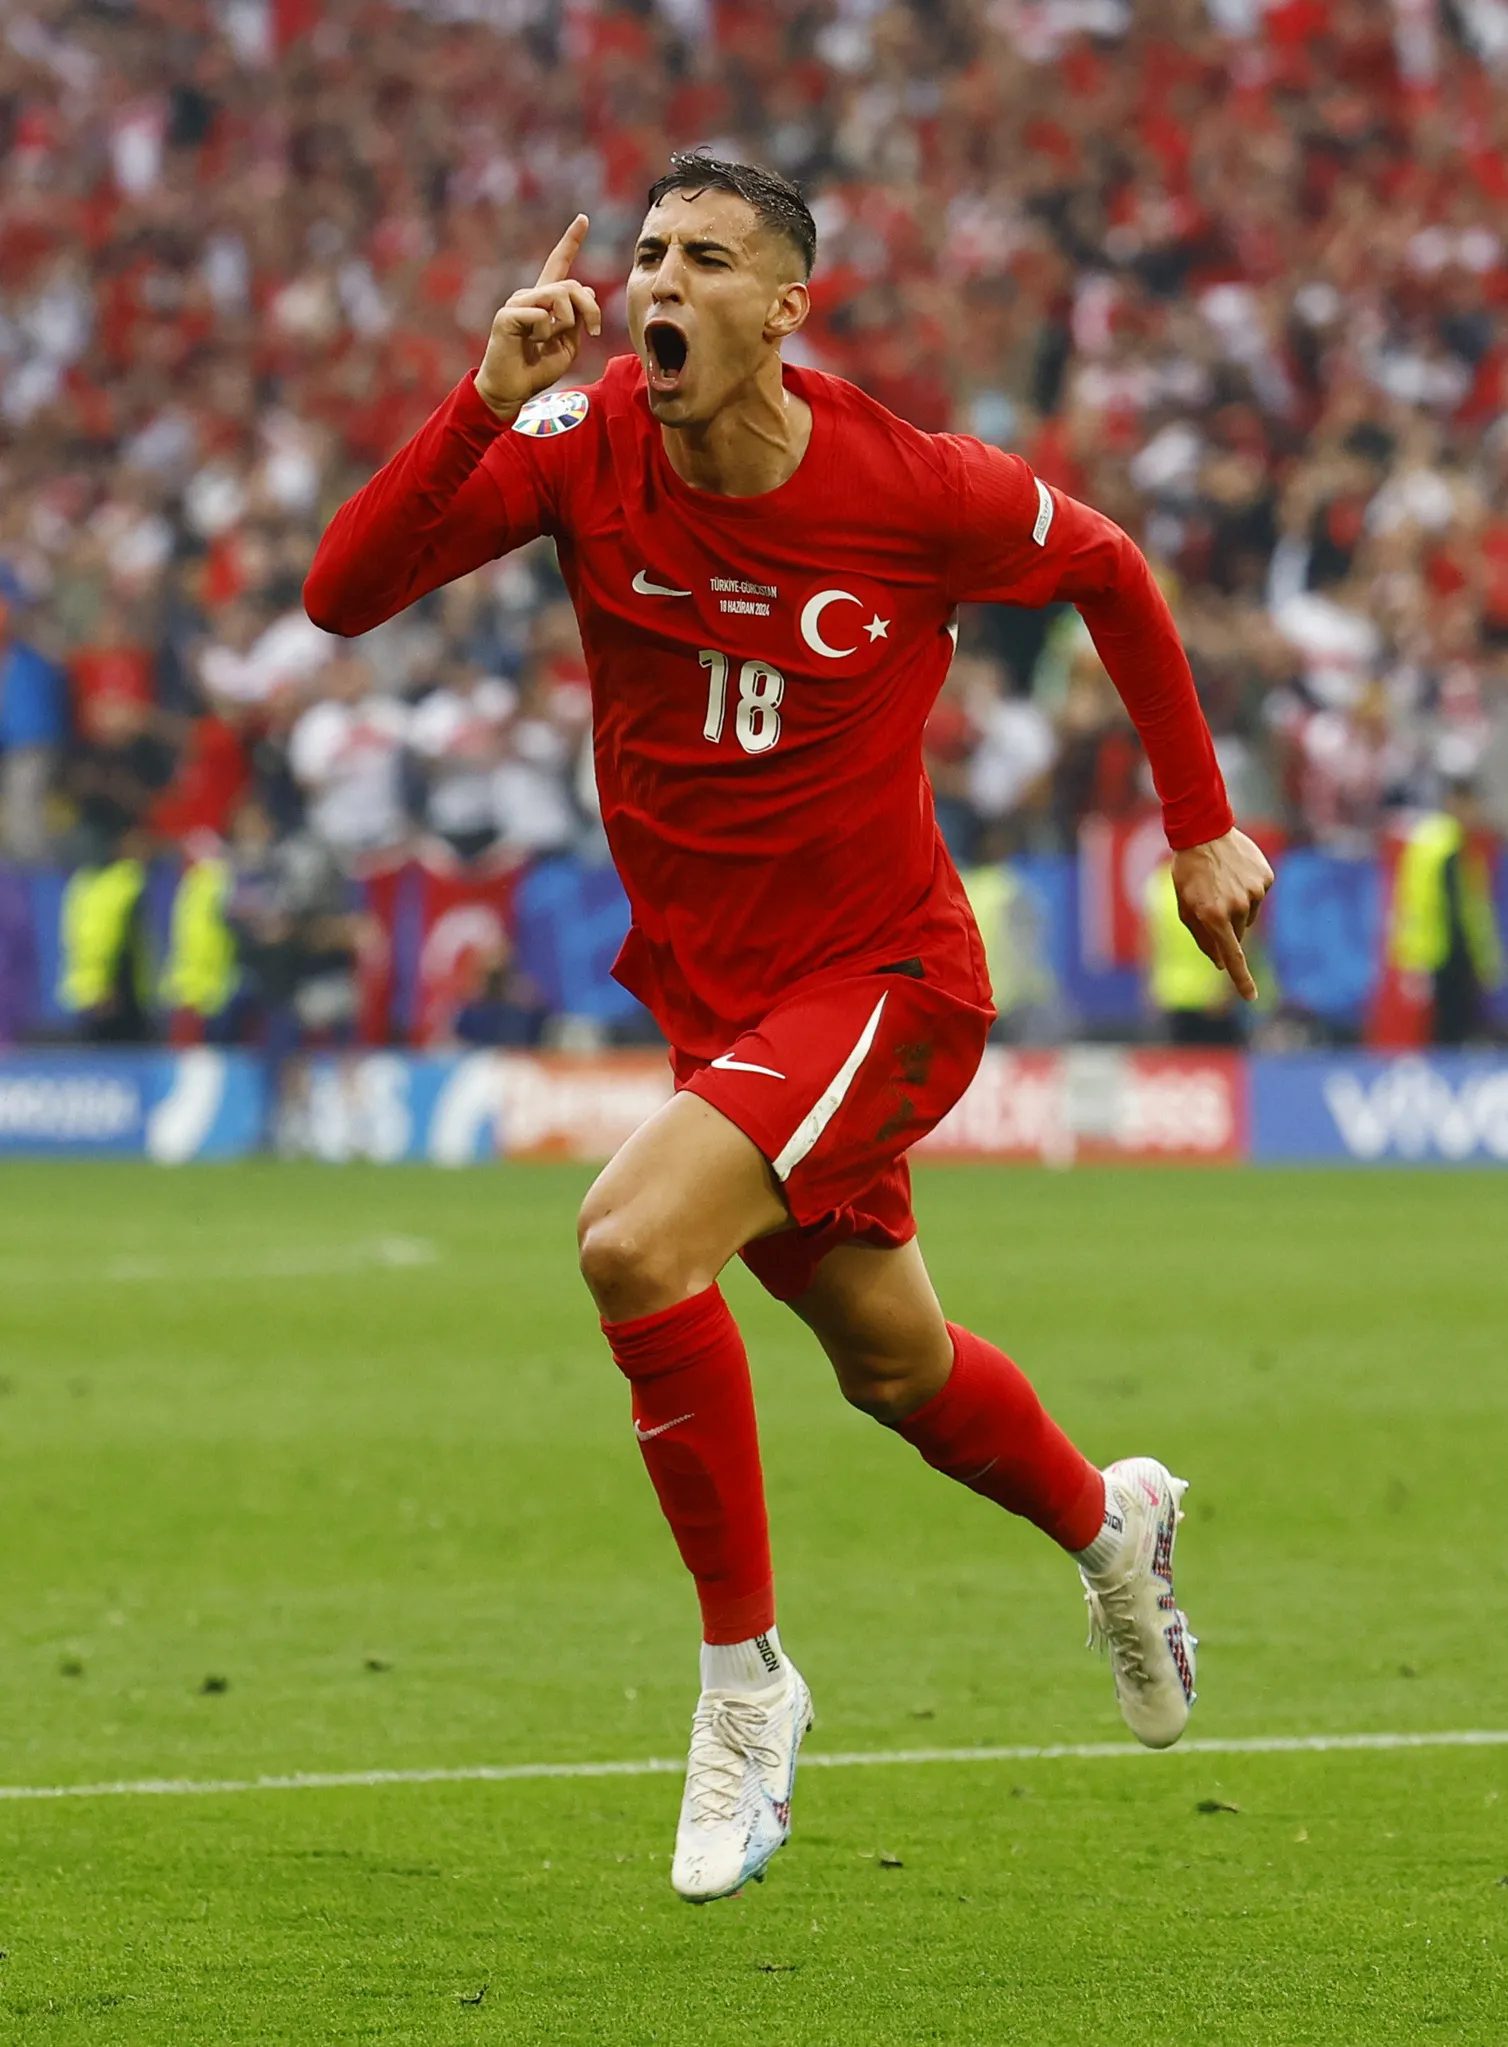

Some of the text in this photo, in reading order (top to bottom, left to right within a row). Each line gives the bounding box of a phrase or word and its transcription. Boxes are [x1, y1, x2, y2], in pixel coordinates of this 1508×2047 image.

[727, 599, 756, 615] HAZİRAN
[755, 602, 770, 616] 2024
[698, 649, 784, 754] 18
